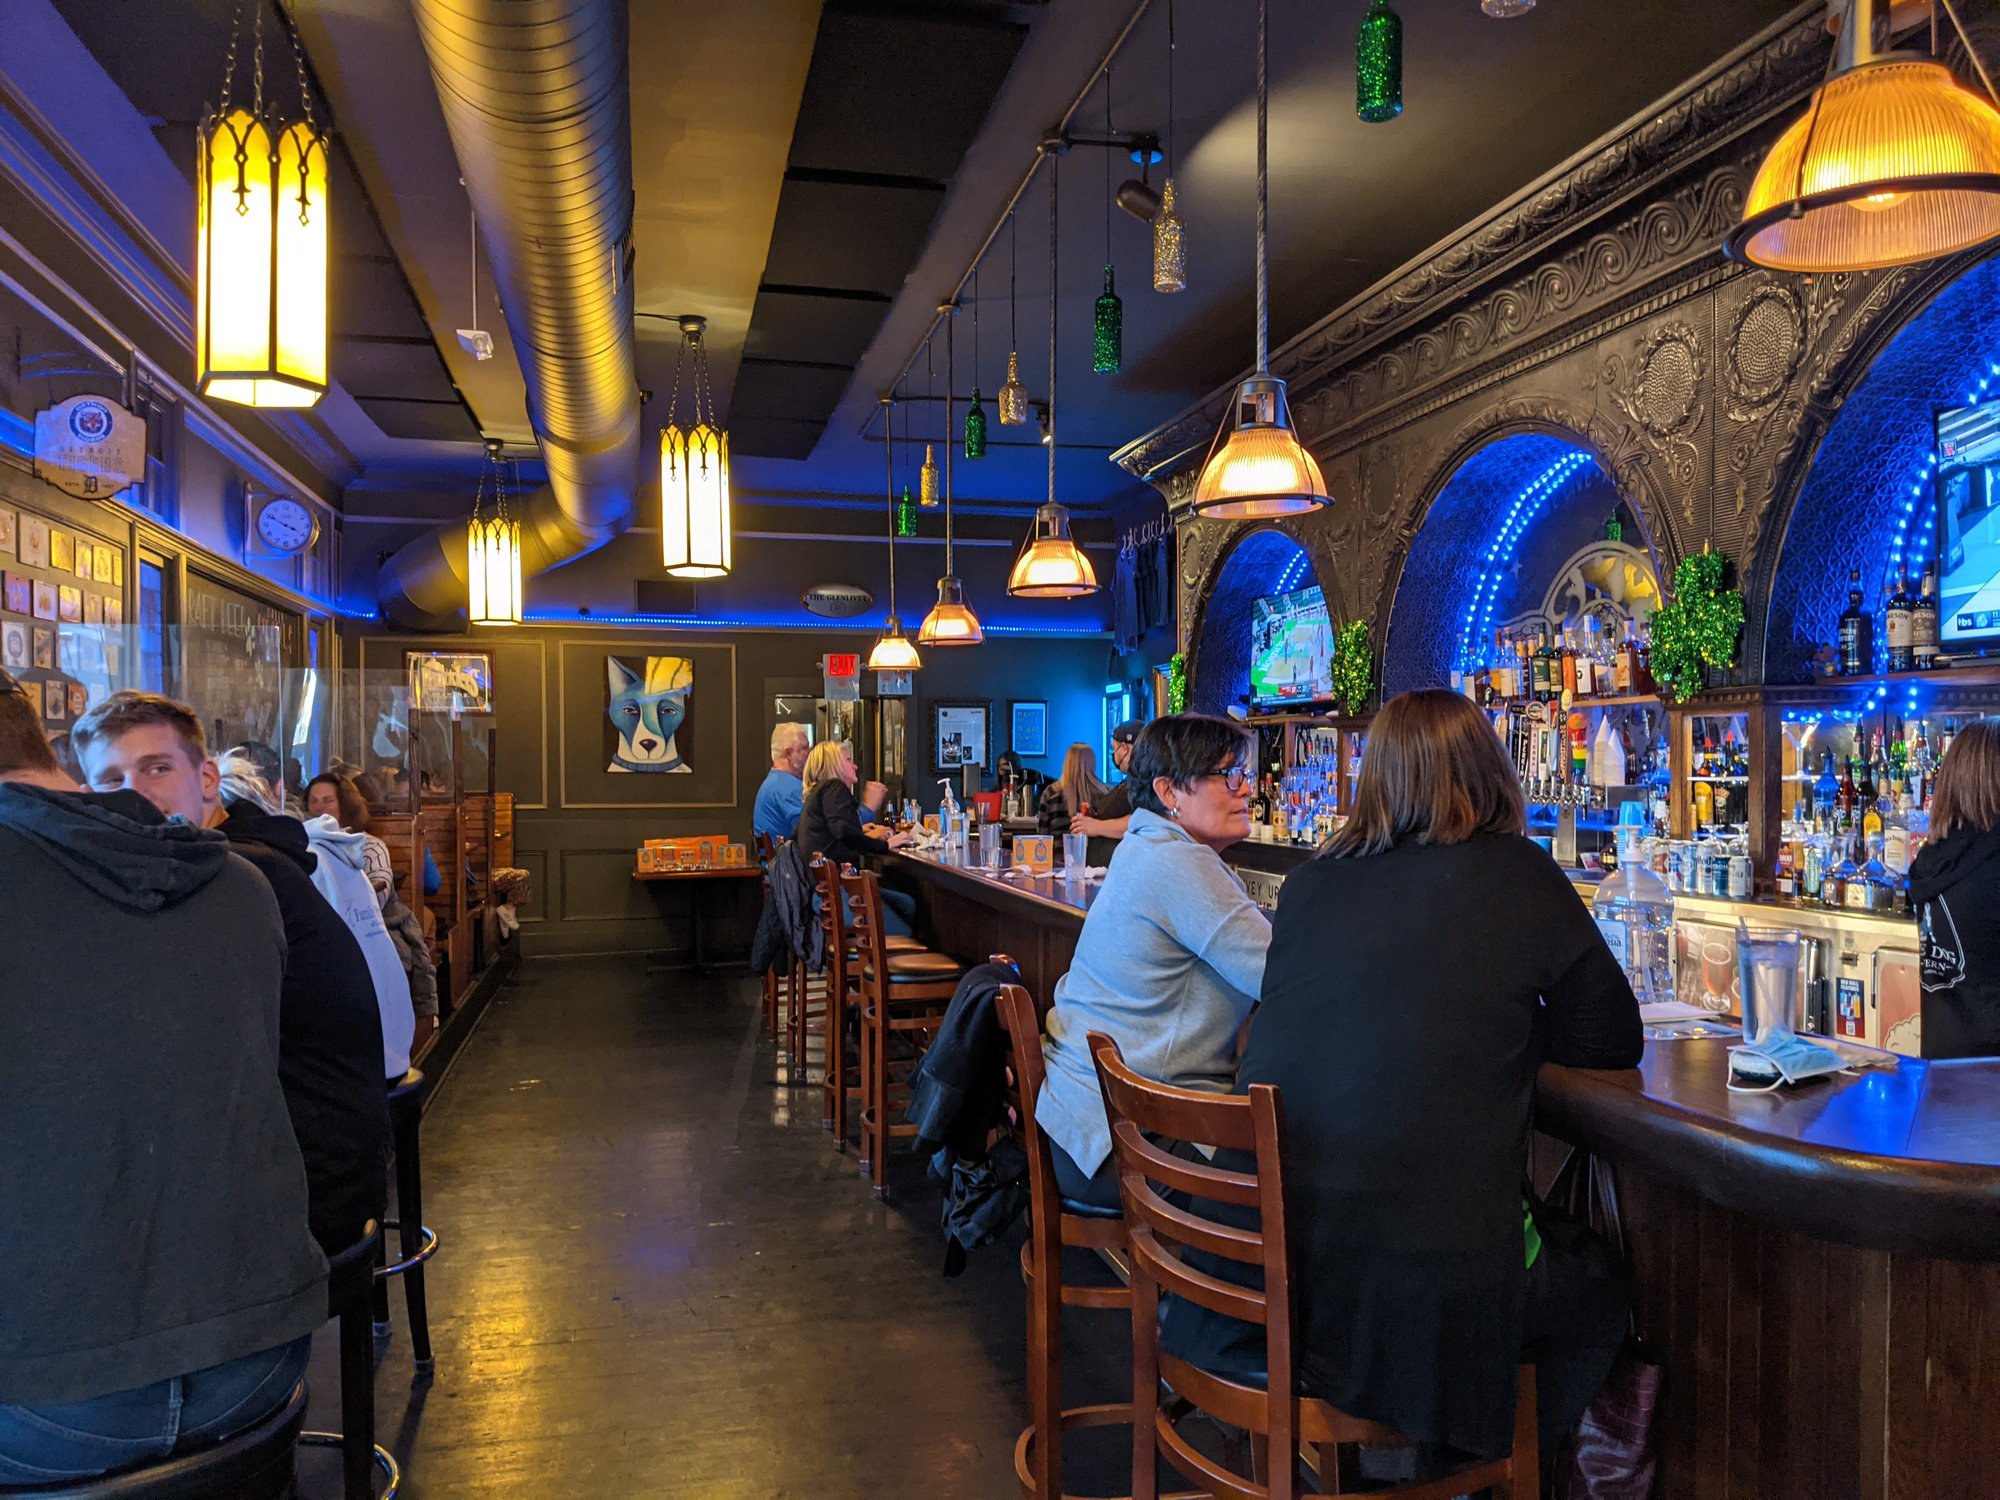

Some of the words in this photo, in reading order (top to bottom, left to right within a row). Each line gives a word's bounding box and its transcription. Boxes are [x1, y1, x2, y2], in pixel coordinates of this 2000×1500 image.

[826, 594, 867, 602] GLENLIVET
[1958, 617, 1972, 627] tbs
[829, 654, 856, 677] EXIT
[1931, 945, 1957, 965] DOG
